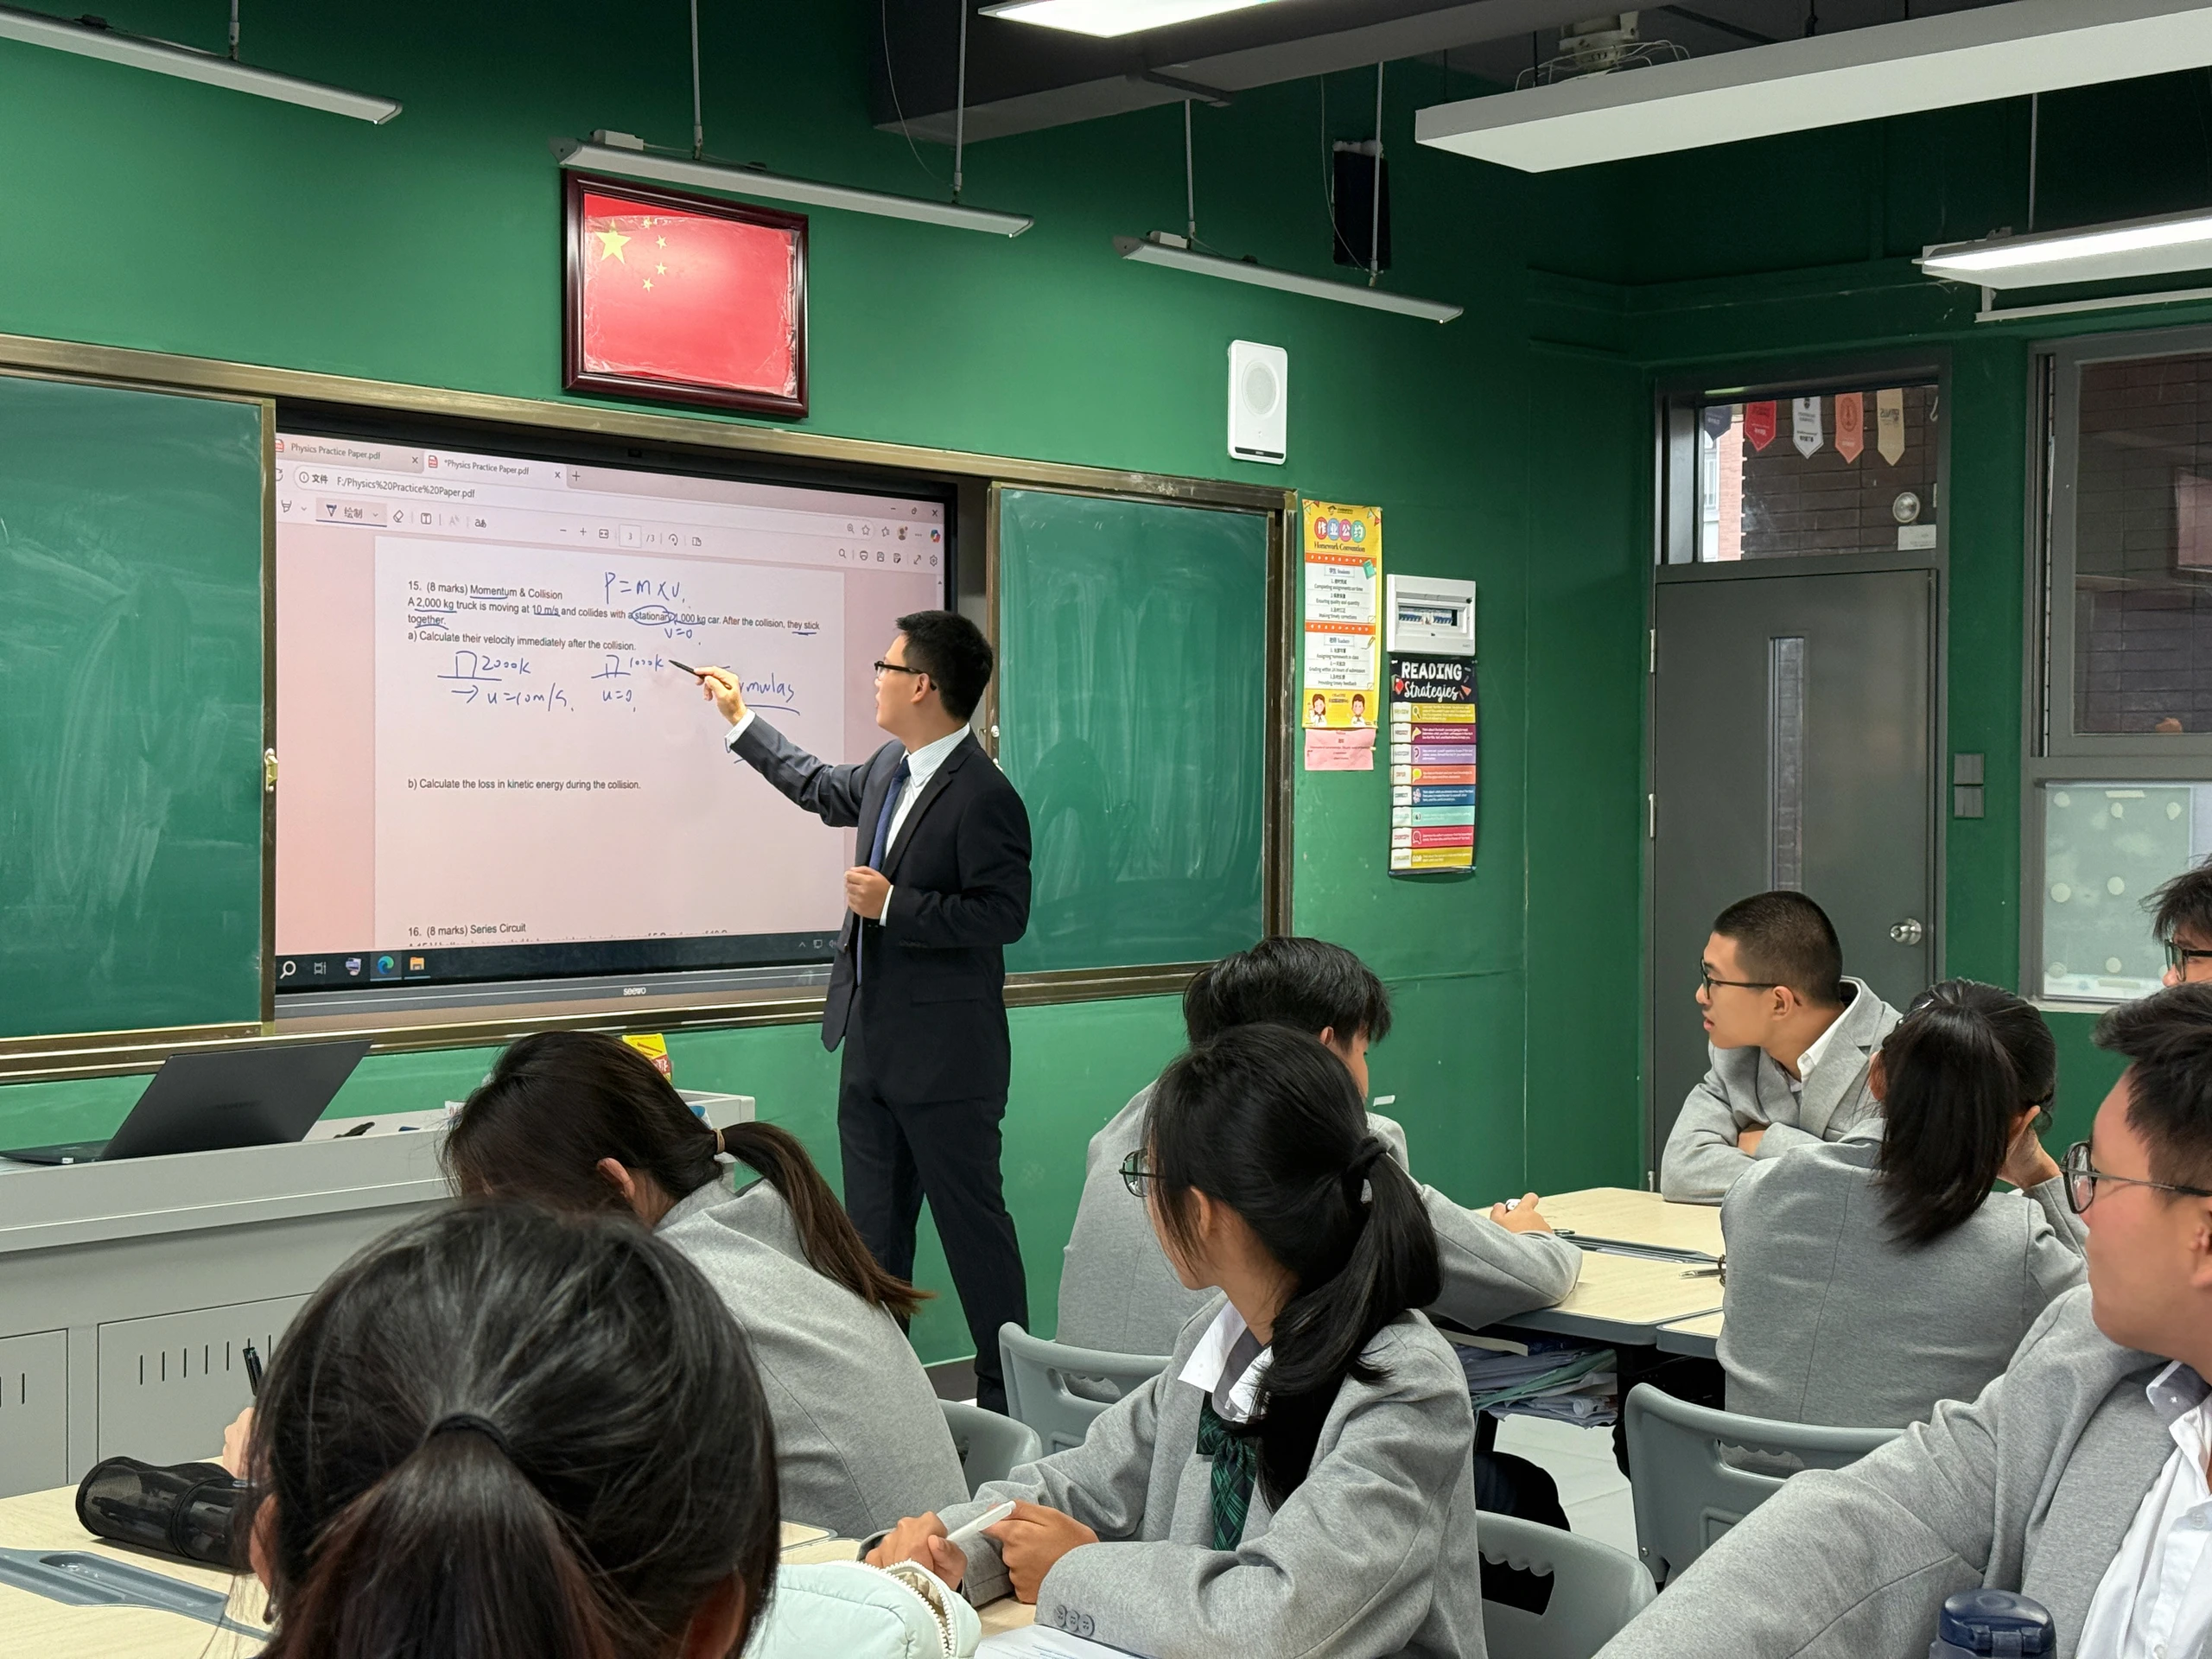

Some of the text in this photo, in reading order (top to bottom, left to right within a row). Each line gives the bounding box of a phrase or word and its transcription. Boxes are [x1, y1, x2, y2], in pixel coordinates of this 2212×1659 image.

[291, 442, 381, 461] Physics Practice Paper.pdf
[473, 461, 498, 472] Practice
[499, 465, 530, 475] Paper.pdf
[312, 474, 328, 485] 文件
[1318, 521, 1363, 539] 作业公约
[408, 580, 563, 600] 15. (8 marks) Momentum & Collision
[408, 597, 415, 606] A
[416, 598, 441, 609] 2,000
[443, 599, 454, 610] kg
[456, 601, 477, 611] truck
[480, 601, 486, 611] is
[489, 602, 519, 614] moving
[521, 605, 530, 613] at
[532, 605, 543, 614] 10
[543, 606, 559, 616] m/s
[561, 607, 575, 616] and
[578, 607, 607, 618] collides
[610, 609, 626, 619] with
[635, 610, 672, 623] stationary
[697, 614, 706, 626] kg
[707, 616, 721, 625] car.
[722, 615, 741, 626] After
[741, 617, 753, 626] the
[754, 618, 785, 629] collision,
[787, 620, 802, 631] they
[804, 620, 820, 631] stick
[408, 614, 447, 627] together.
[408, 631, 636, 651] a) Calculate their velocity immediately after the collision.
[1402, 661, 1462, 681] READING
[1404, 681, 1459, 702] Strategies
[408, 779, 640, 791] b) Calculate the loss in kinetic energy during the collision.
[408, 923, 526, 938] 16. (8 marks) Series Circuit
